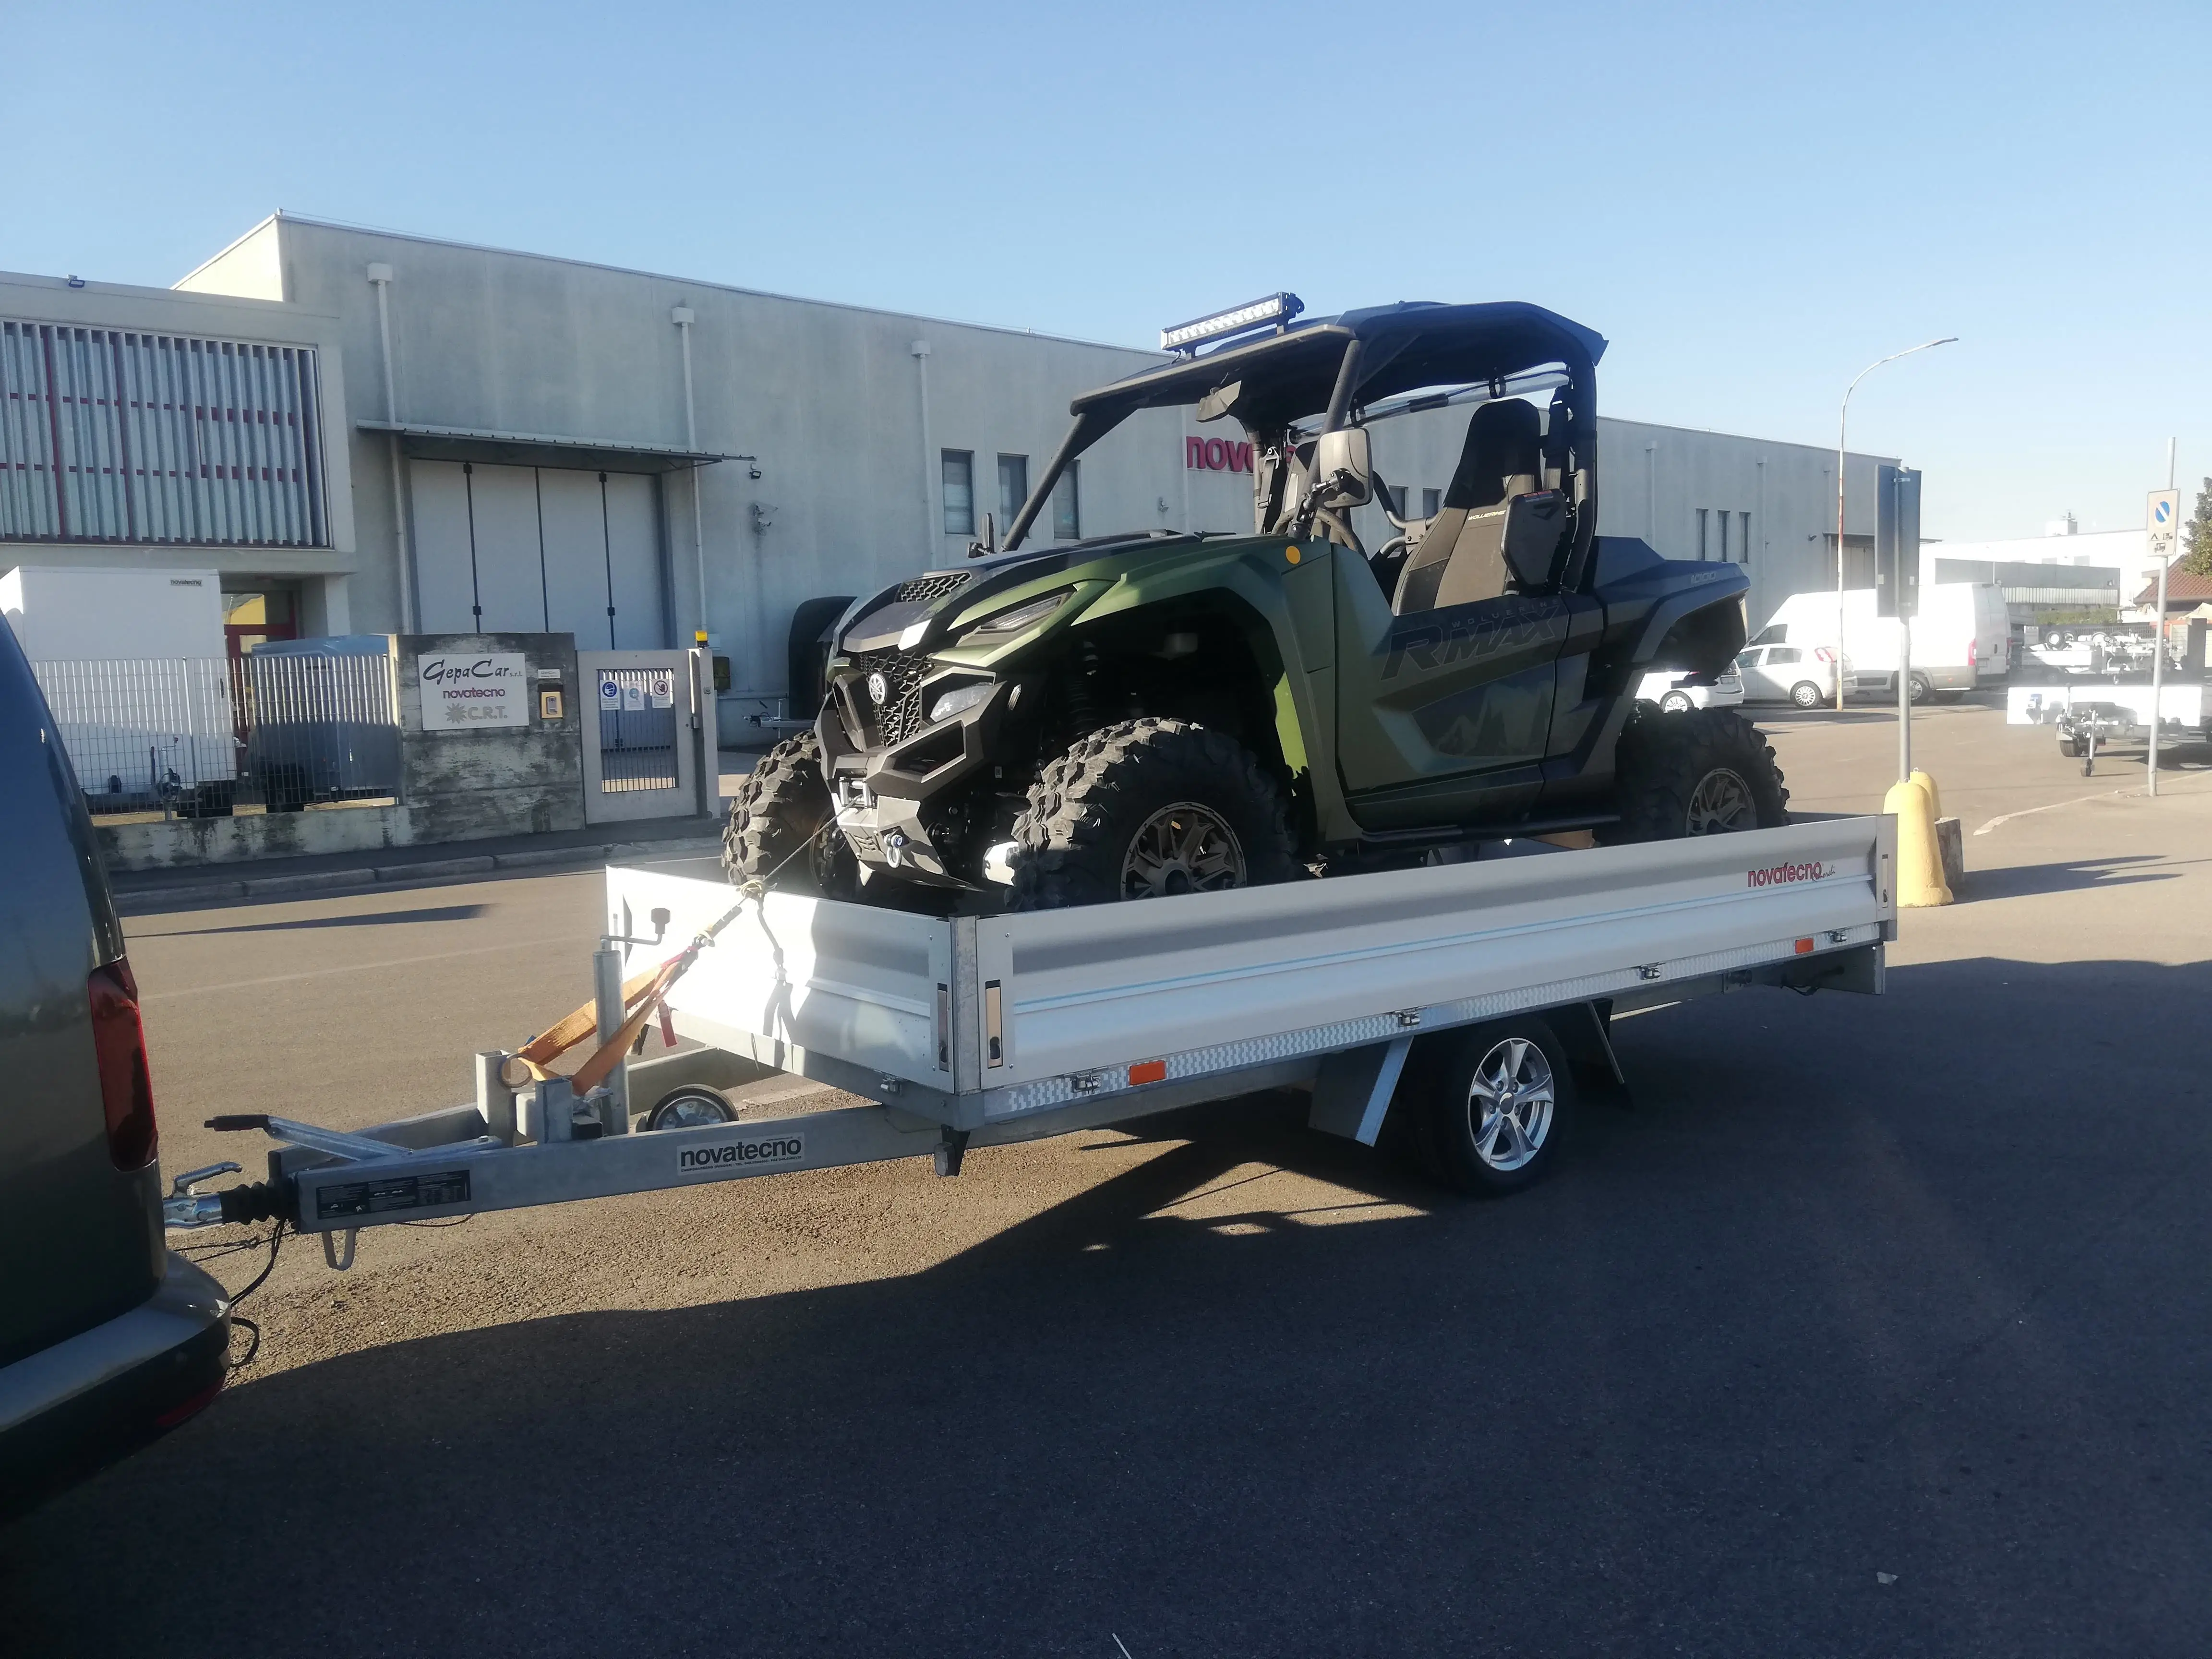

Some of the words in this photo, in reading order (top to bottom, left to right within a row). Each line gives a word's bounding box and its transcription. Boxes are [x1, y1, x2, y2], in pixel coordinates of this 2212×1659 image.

[443, 687, 505, 699] novatecno
[467, 706, 508, 720] C.R.T.
[1748, 862, 1822, 888] novatecno
[681, 1139, 802, 1167] novatecno
